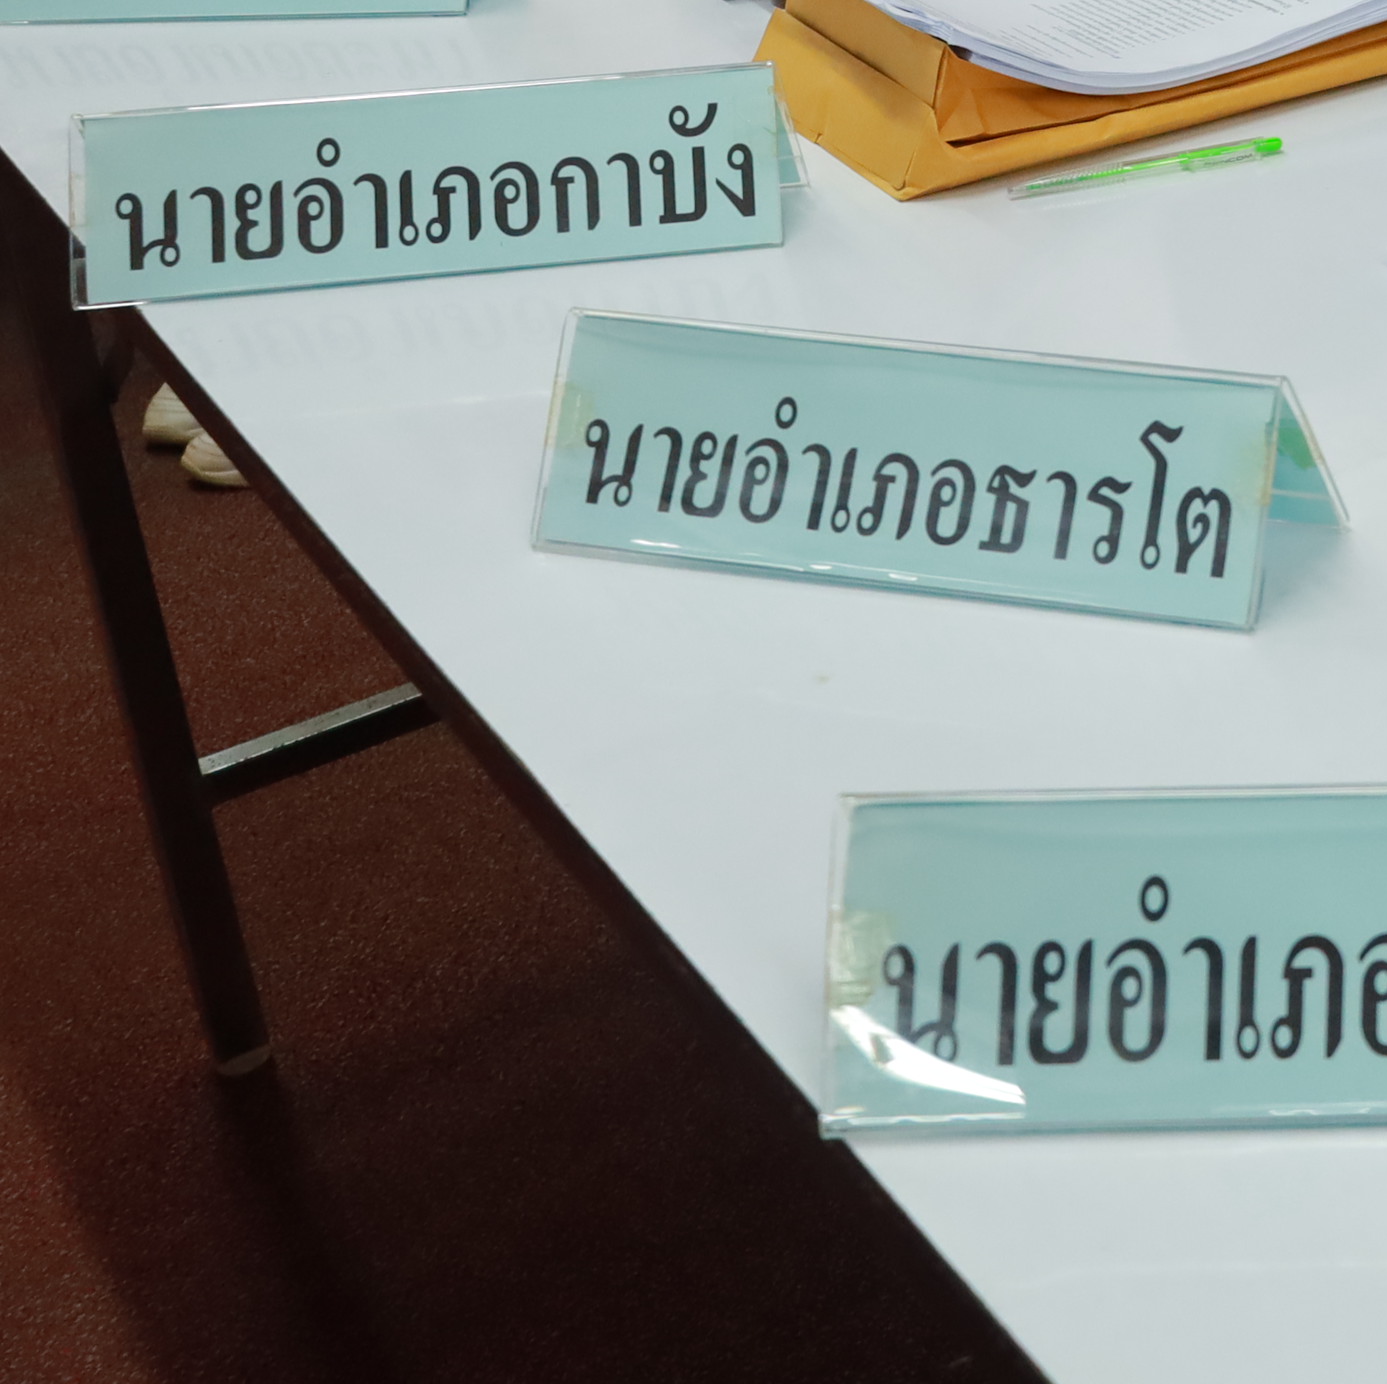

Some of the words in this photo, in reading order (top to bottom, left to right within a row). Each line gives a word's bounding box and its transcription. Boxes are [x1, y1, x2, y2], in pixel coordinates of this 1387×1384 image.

[115, 103, 756, 271] นายอำเภอกาบัง
[585, 396, 1232, 578] นายอำเภอธารโต
